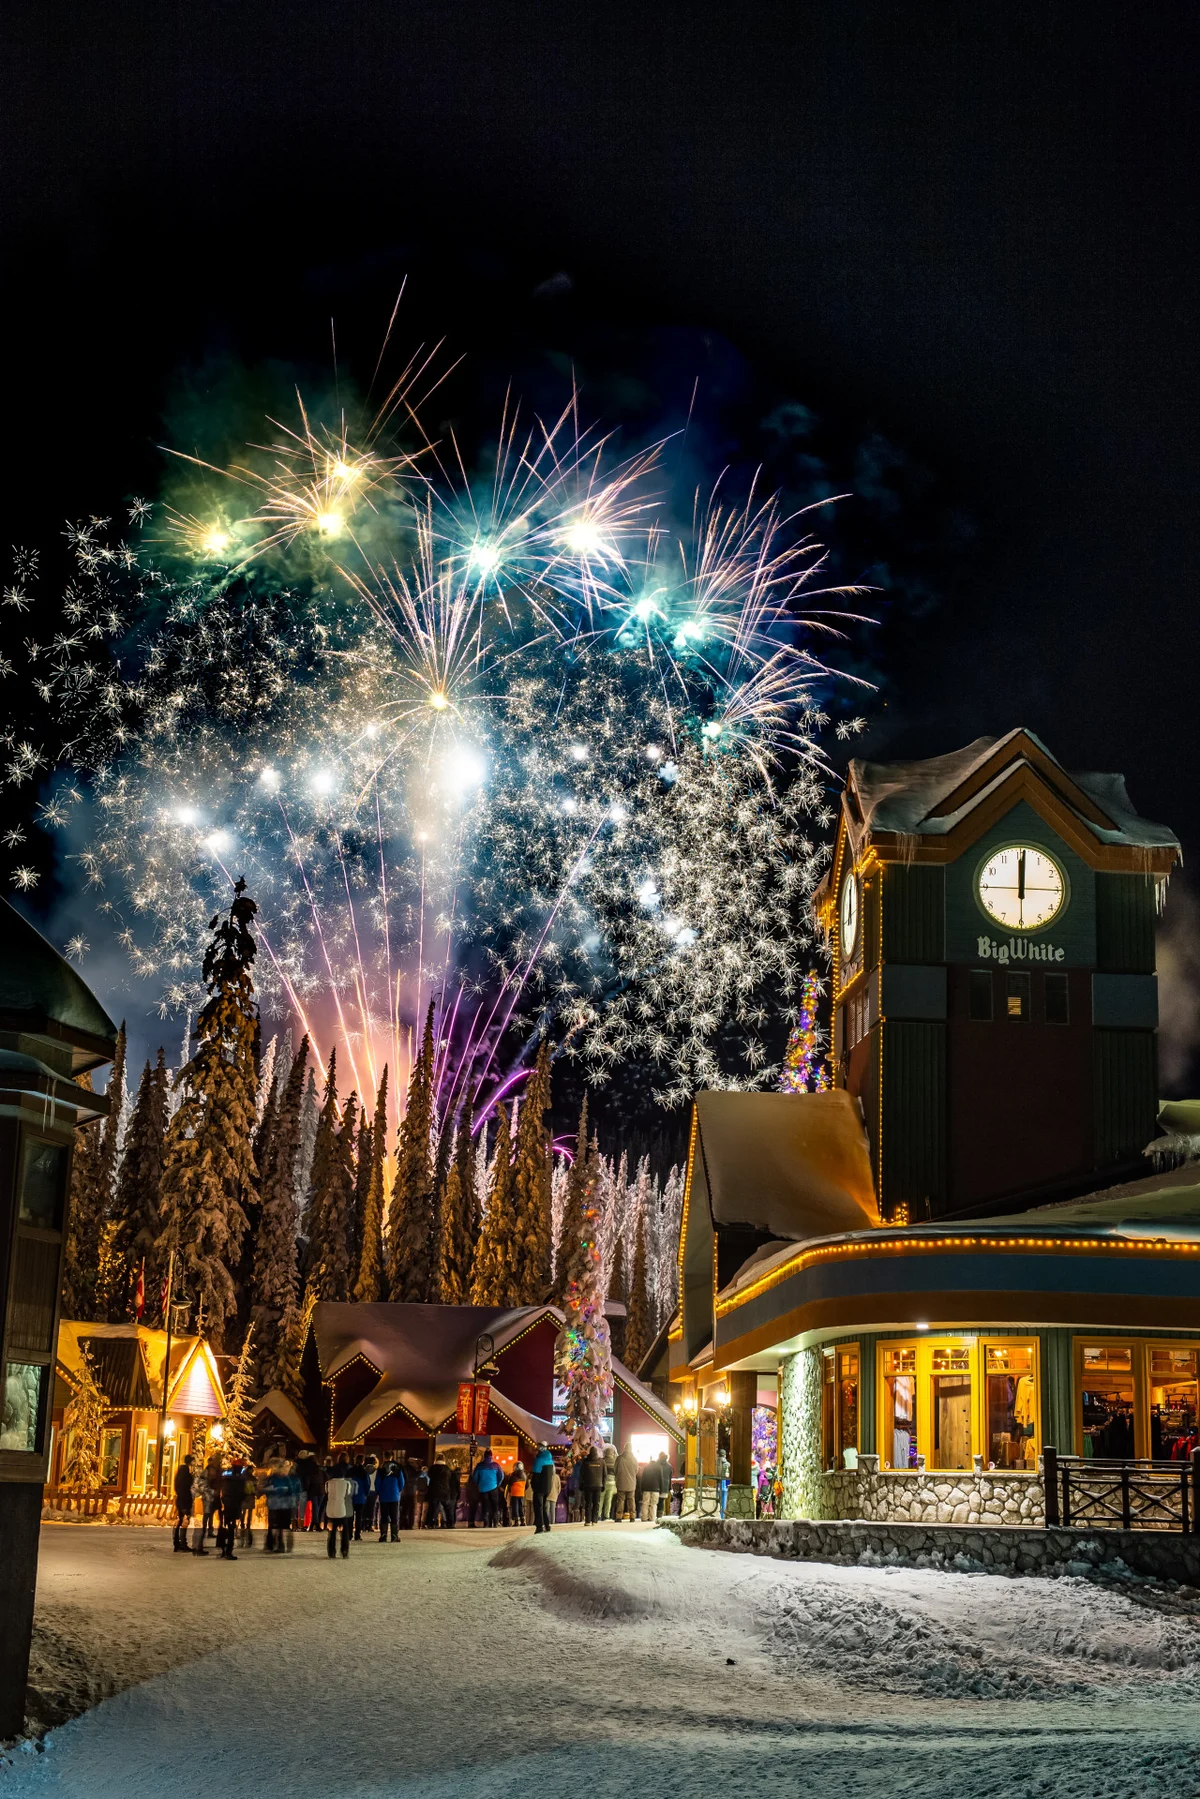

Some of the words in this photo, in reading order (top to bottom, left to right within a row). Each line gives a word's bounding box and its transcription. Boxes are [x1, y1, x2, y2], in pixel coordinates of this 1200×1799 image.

[1001, 855, 1007, 864] 11
[988, 867, 997, 875] 10
[1048, 869, 1054, 878] 2
[982, 883, 989, 891] 9
[987, 901, 994, 909] 8
[1047, 903, 1054, 911] 4
[1001, 912, 1007, 920] 7
[1037, 914, 1042, 922] 5
